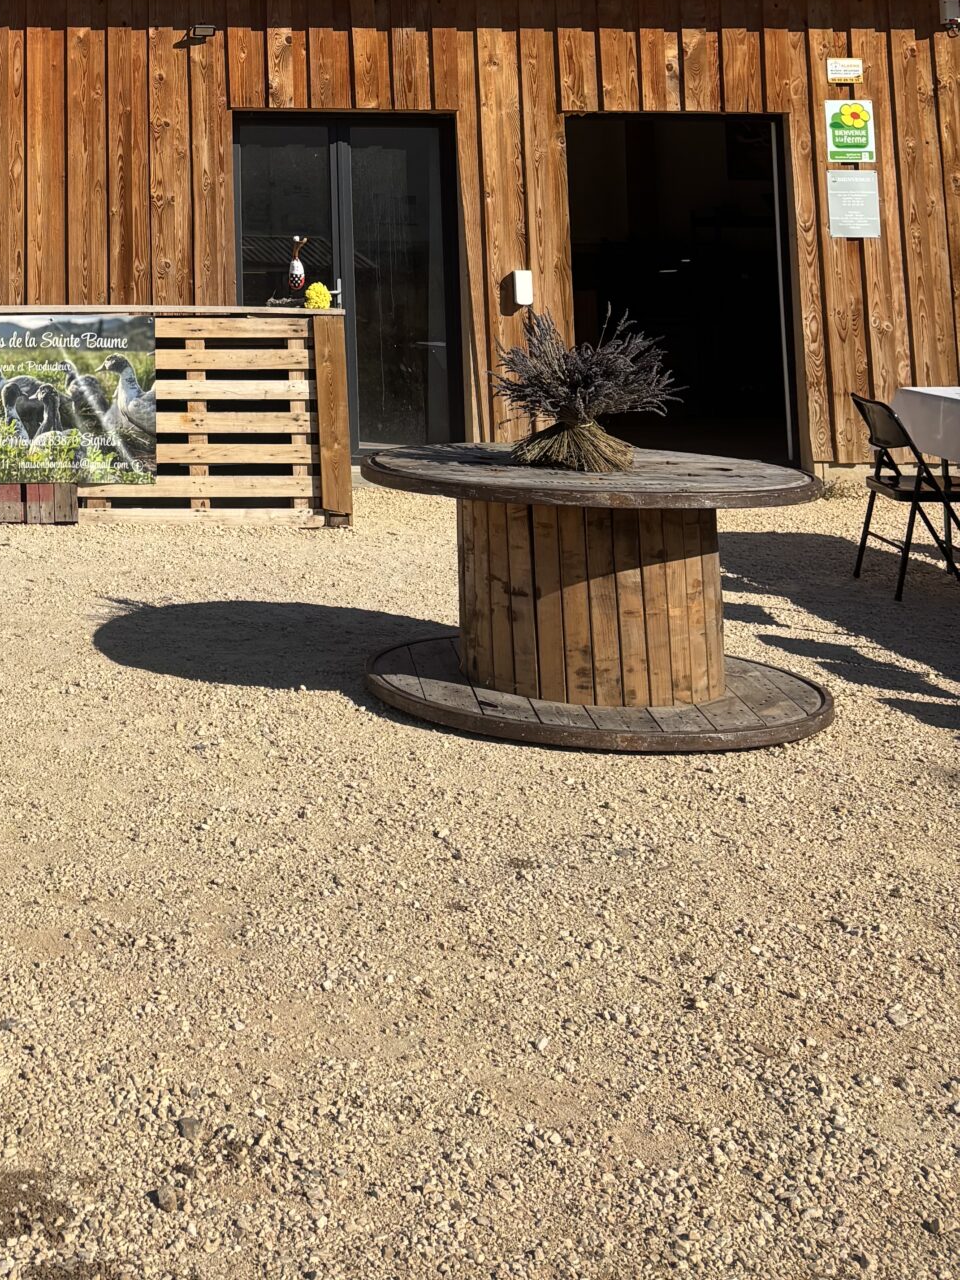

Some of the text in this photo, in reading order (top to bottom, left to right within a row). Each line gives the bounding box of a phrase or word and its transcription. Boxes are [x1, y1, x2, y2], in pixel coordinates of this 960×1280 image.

[834, 129, 867, 137] BIENVENUE
[844, 135, 867, 144] ferme
[9, 331, 23, 348] de
[25, 331, 38, 348] la
[40, 331, 80, 348] Sainte
[81, 332, 129, 349] Baume
[17, 362, 25, 372] et
[25, 360, 72, 373] Producteur
[79, 432, 116, 451] Signes
